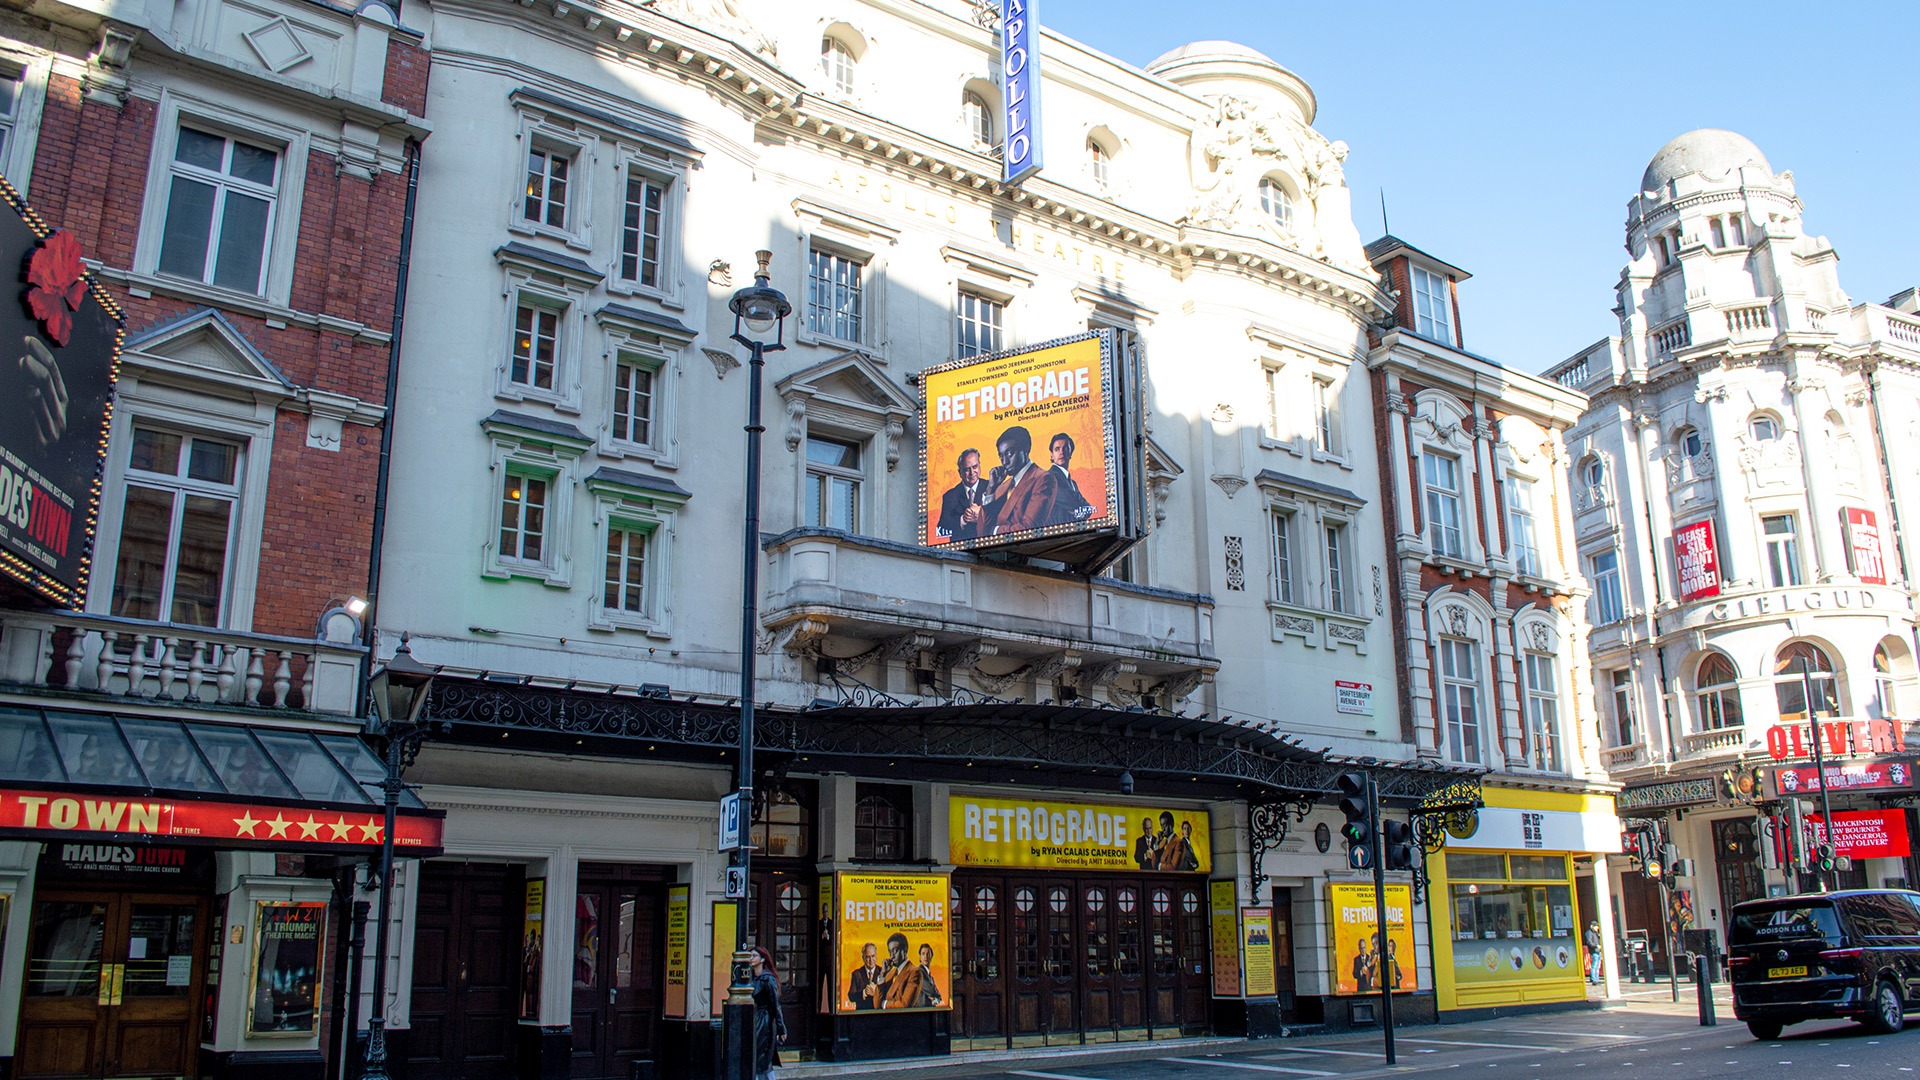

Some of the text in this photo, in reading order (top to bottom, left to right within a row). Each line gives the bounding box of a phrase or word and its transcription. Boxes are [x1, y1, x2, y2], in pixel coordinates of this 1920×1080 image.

[1004, 0, 1030, 165] APOLLO
[828, 169, 1125, 280] APOLLO THEATRE
[957, 359, 1067, 387] STANLEY TOWNSEND OLIVER JOHNSTONE
[986, 358, 1035, 373] IVANNO JEREMIAH
[936, 367, 1089, 423] RETROGRADE
[994, 395, 1090, 421] by RYAN CALAIS CAMERON
[1017, 412, 1041, 422] Directed
[1049, 407, 1064, 415] AMIT
[1064, 402, 1089, 412] SHARMA
[1677, 526, 1707, 546] PLEASE
[1681, 549, 1713, 568] WANT
[1681, 564, 1706, 581] SOME
[1681, 570, 1717, 596] MORE!
[1712, 590, 1875, 621] GIELGUD
[1339, 689, 1371, 700] SHAFTESBURY
[1340, 697, 1357, 706] AVENUE
[1828, 776, 1846, 787] FOR
[729, 802, 737, 829] P
[1834, 819, 1884, 828] MACKINTOSH
[964, 803, 1127, 848] RETROGRADE
[1834, 840, 1855, 848] NEW
[1842, 832, 1888, 841] DANGEROUS
[1030, 846, 1127, 858] by RYAN CALAIS CAMERON
[98, 864, 121, 872] MITCHELL
[1056, 856, 1128, 866] Directed by AMIT SHARMA
[845, 900, 943, 922] RETROGRADE
[265, 922, 317, 932] A TRIUMPH
[1756, 924, 1806, 935] ADDISON LEE
[1771, 967, 1789, 977] GL73
